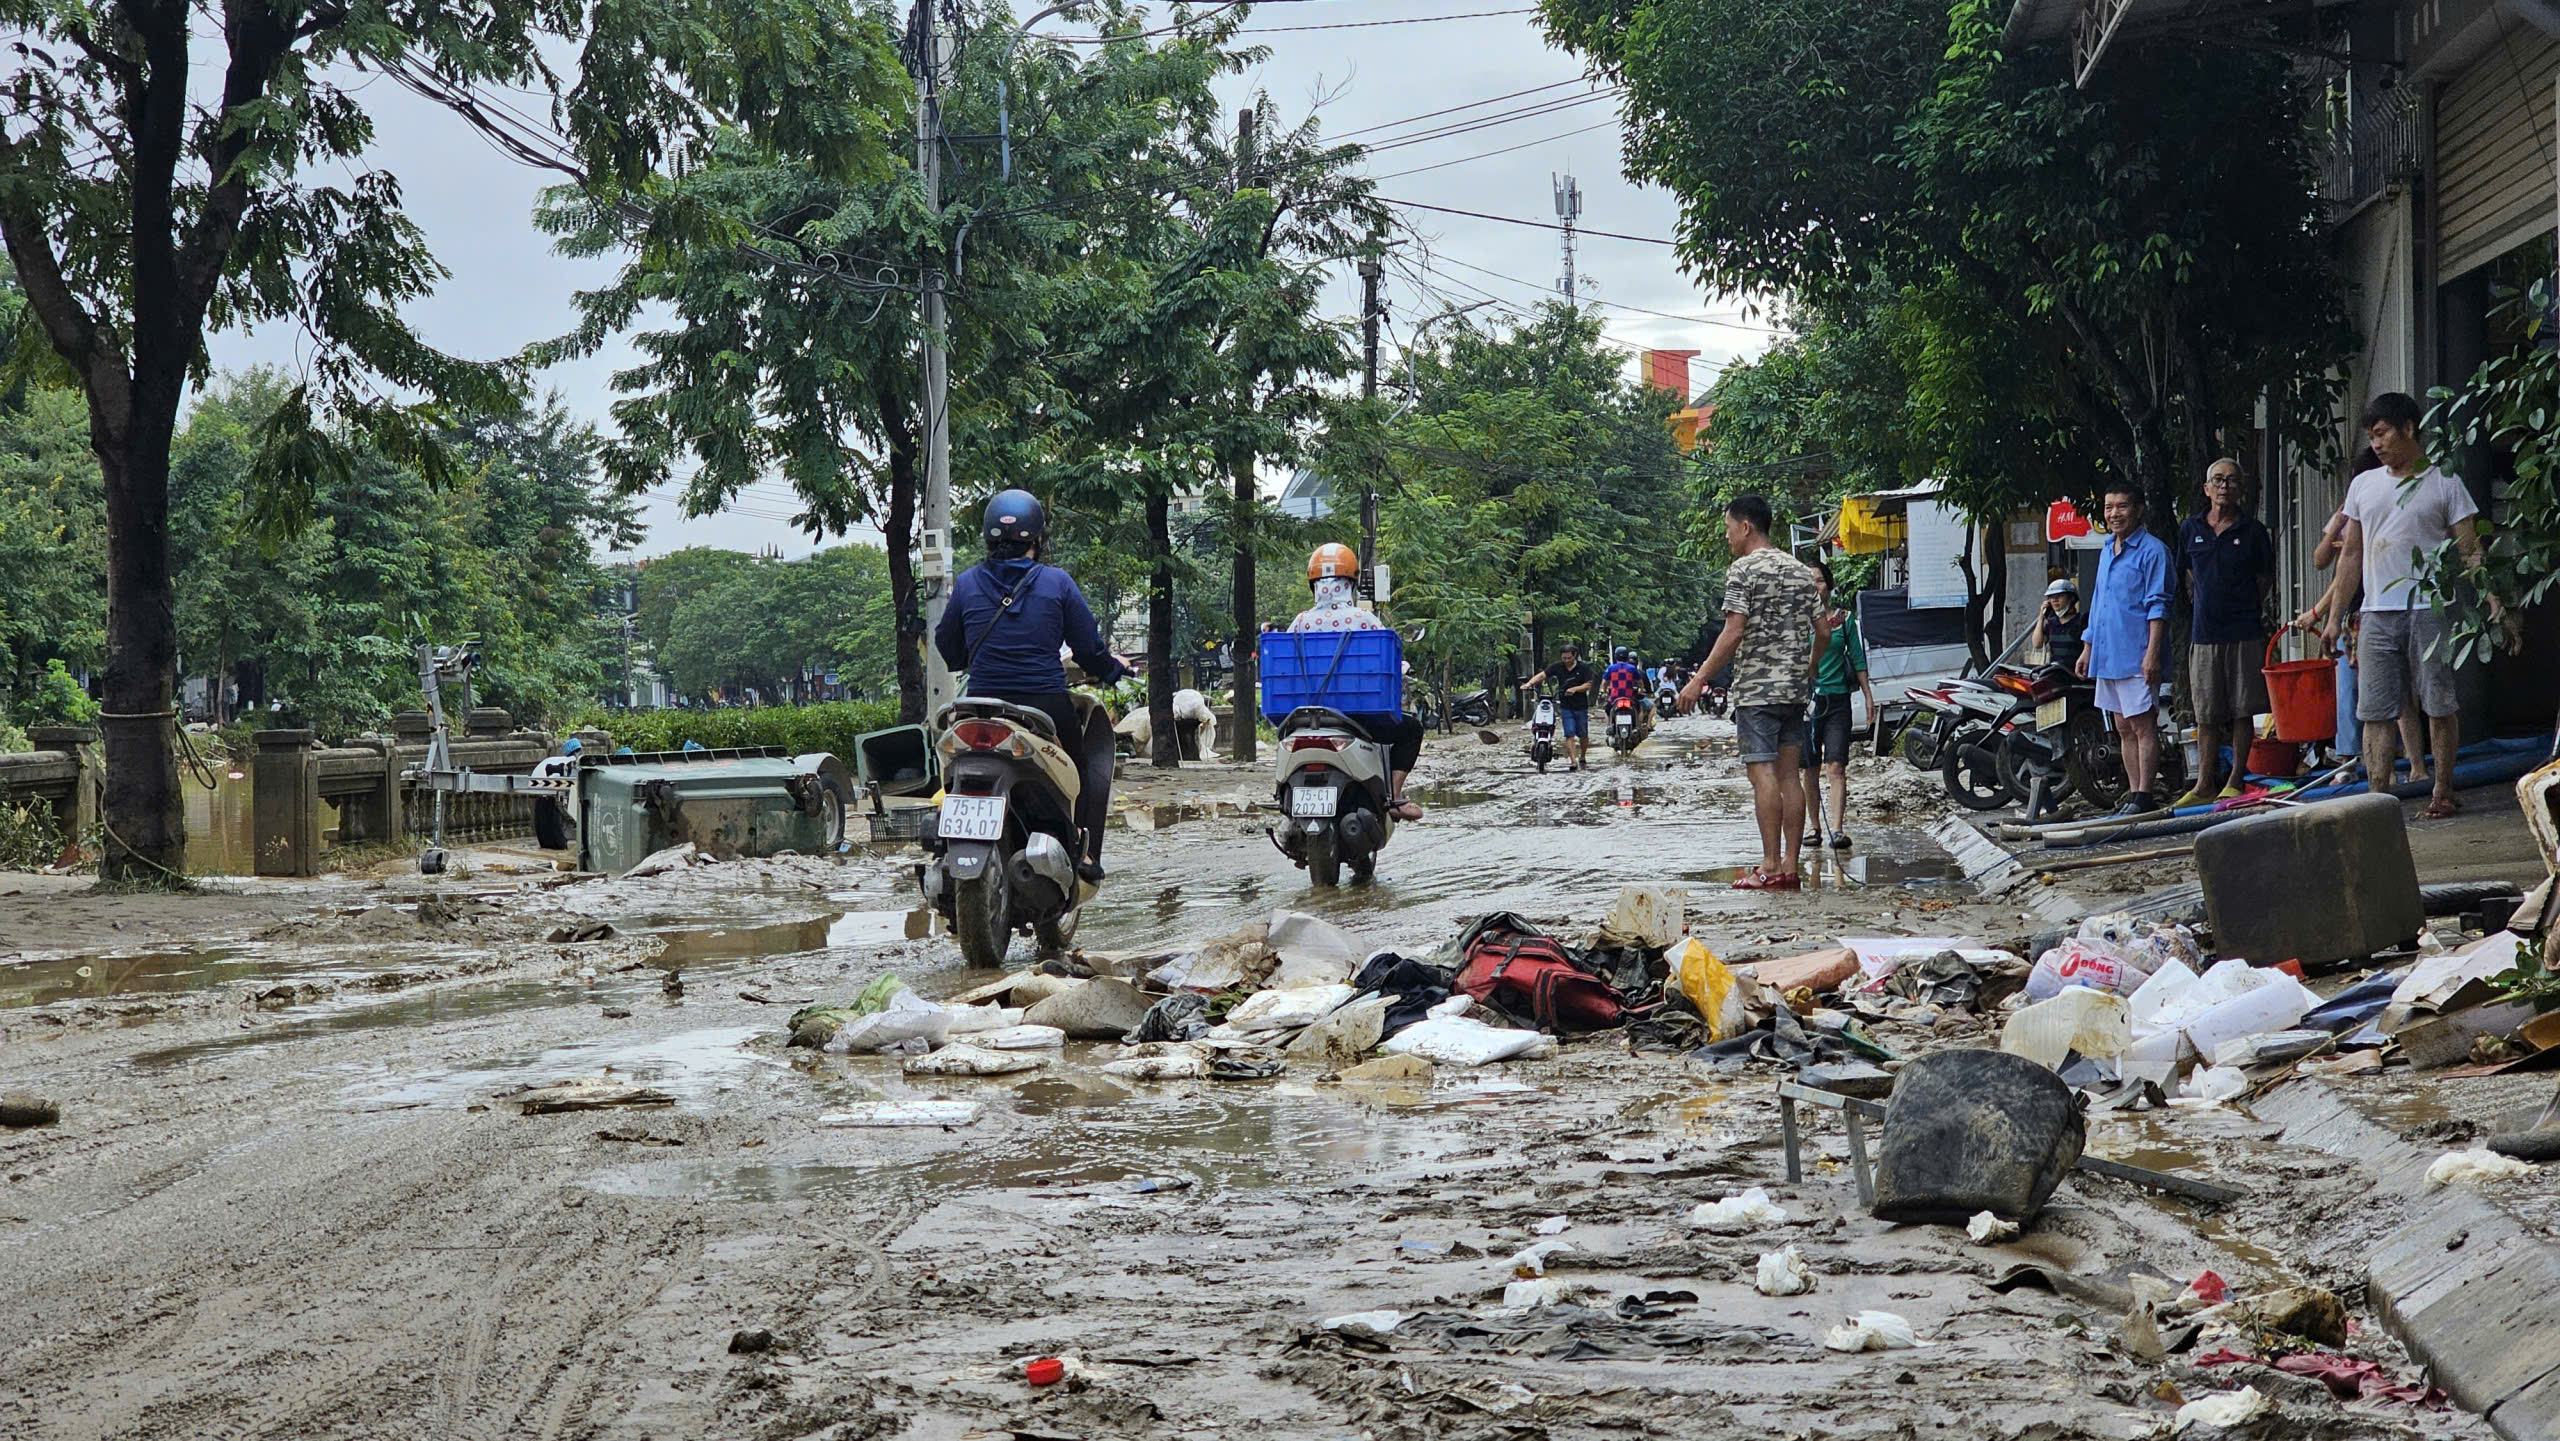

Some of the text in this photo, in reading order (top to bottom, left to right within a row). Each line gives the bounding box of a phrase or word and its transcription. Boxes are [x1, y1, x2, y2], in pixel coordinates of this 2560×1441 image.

[1301, 790, 1329, 801] 75-C1
[953, 799, 993, 816] 75-F1
[944, 818, 998, 836] 634.07
